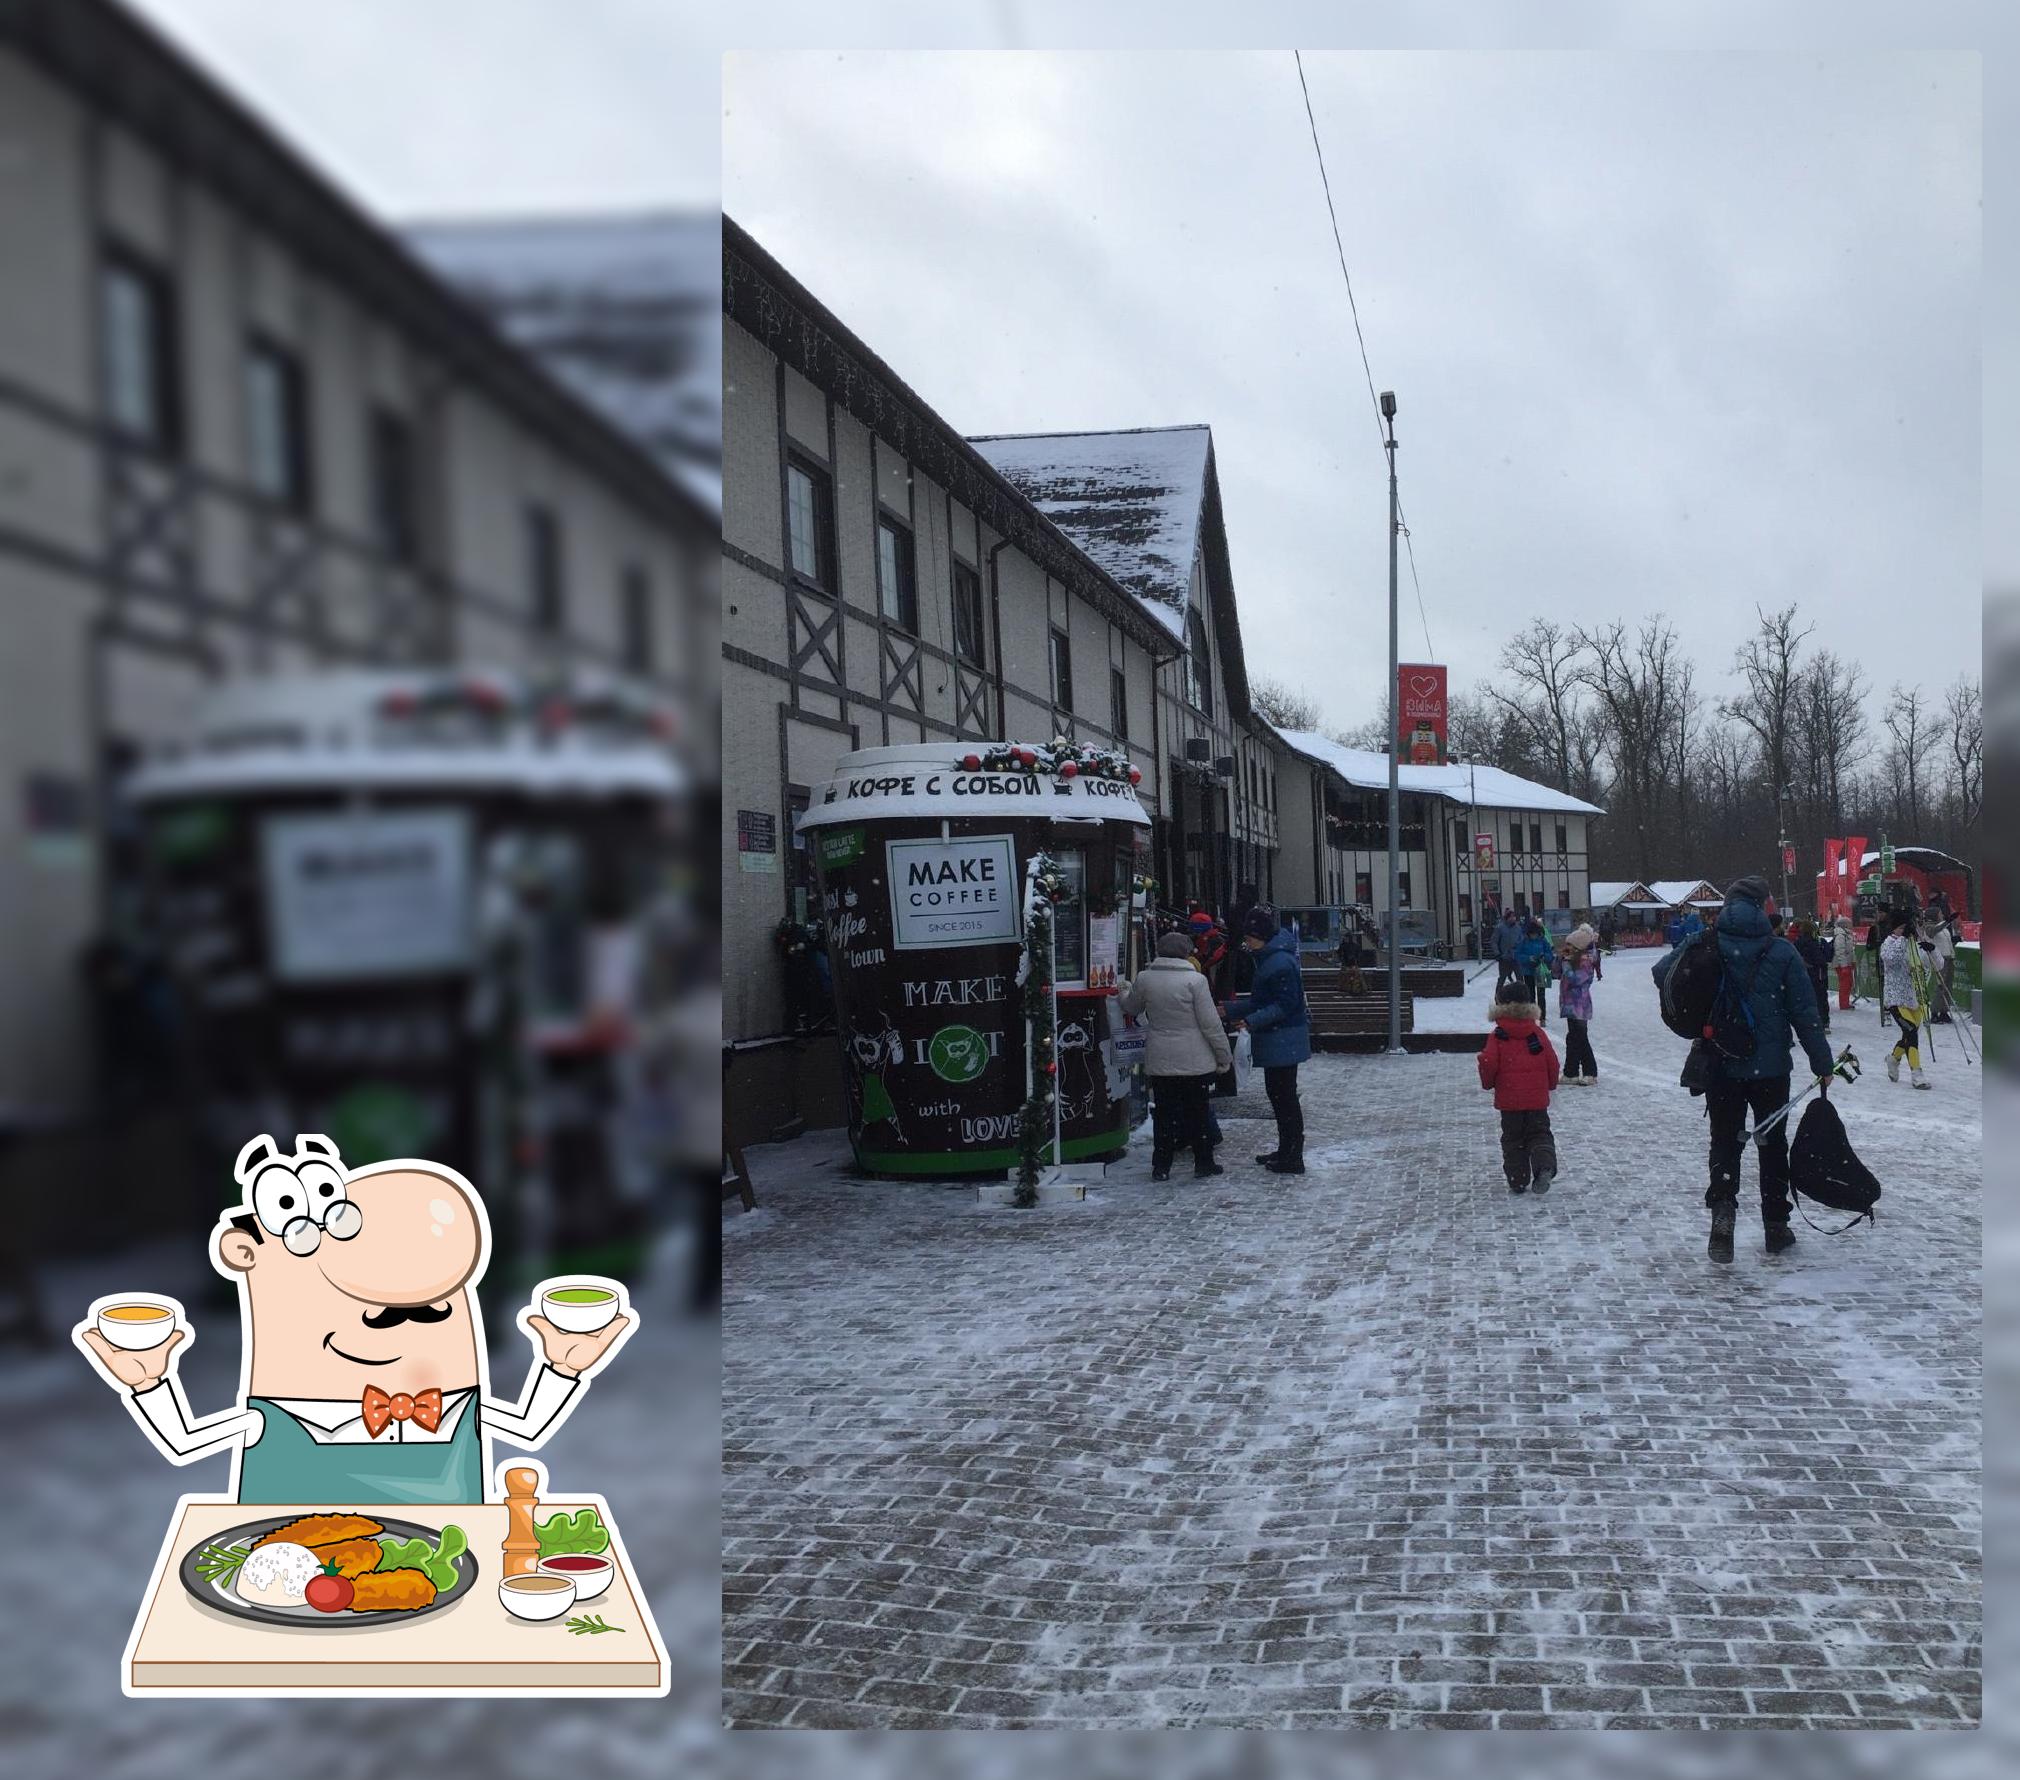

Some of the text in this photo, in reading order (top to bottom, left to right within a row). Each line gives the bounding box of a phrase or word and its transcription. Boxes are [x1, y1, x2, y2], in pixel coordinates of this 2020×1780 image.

[848, 776, 916, 799] КОФЕ
[926, 776, 942, 796] С
[908, 858, 995, 886] MAKE
[909, 888, 998, 907] COFFEE
[928, 921, 983, 933] SINCE 2015
[850, 948, 886, 969] town
[903, 976, 1007, 1007] MAKE
[918, 1099, 961, 1117] with
[961, 1113, 1022, 1143] LOVE
